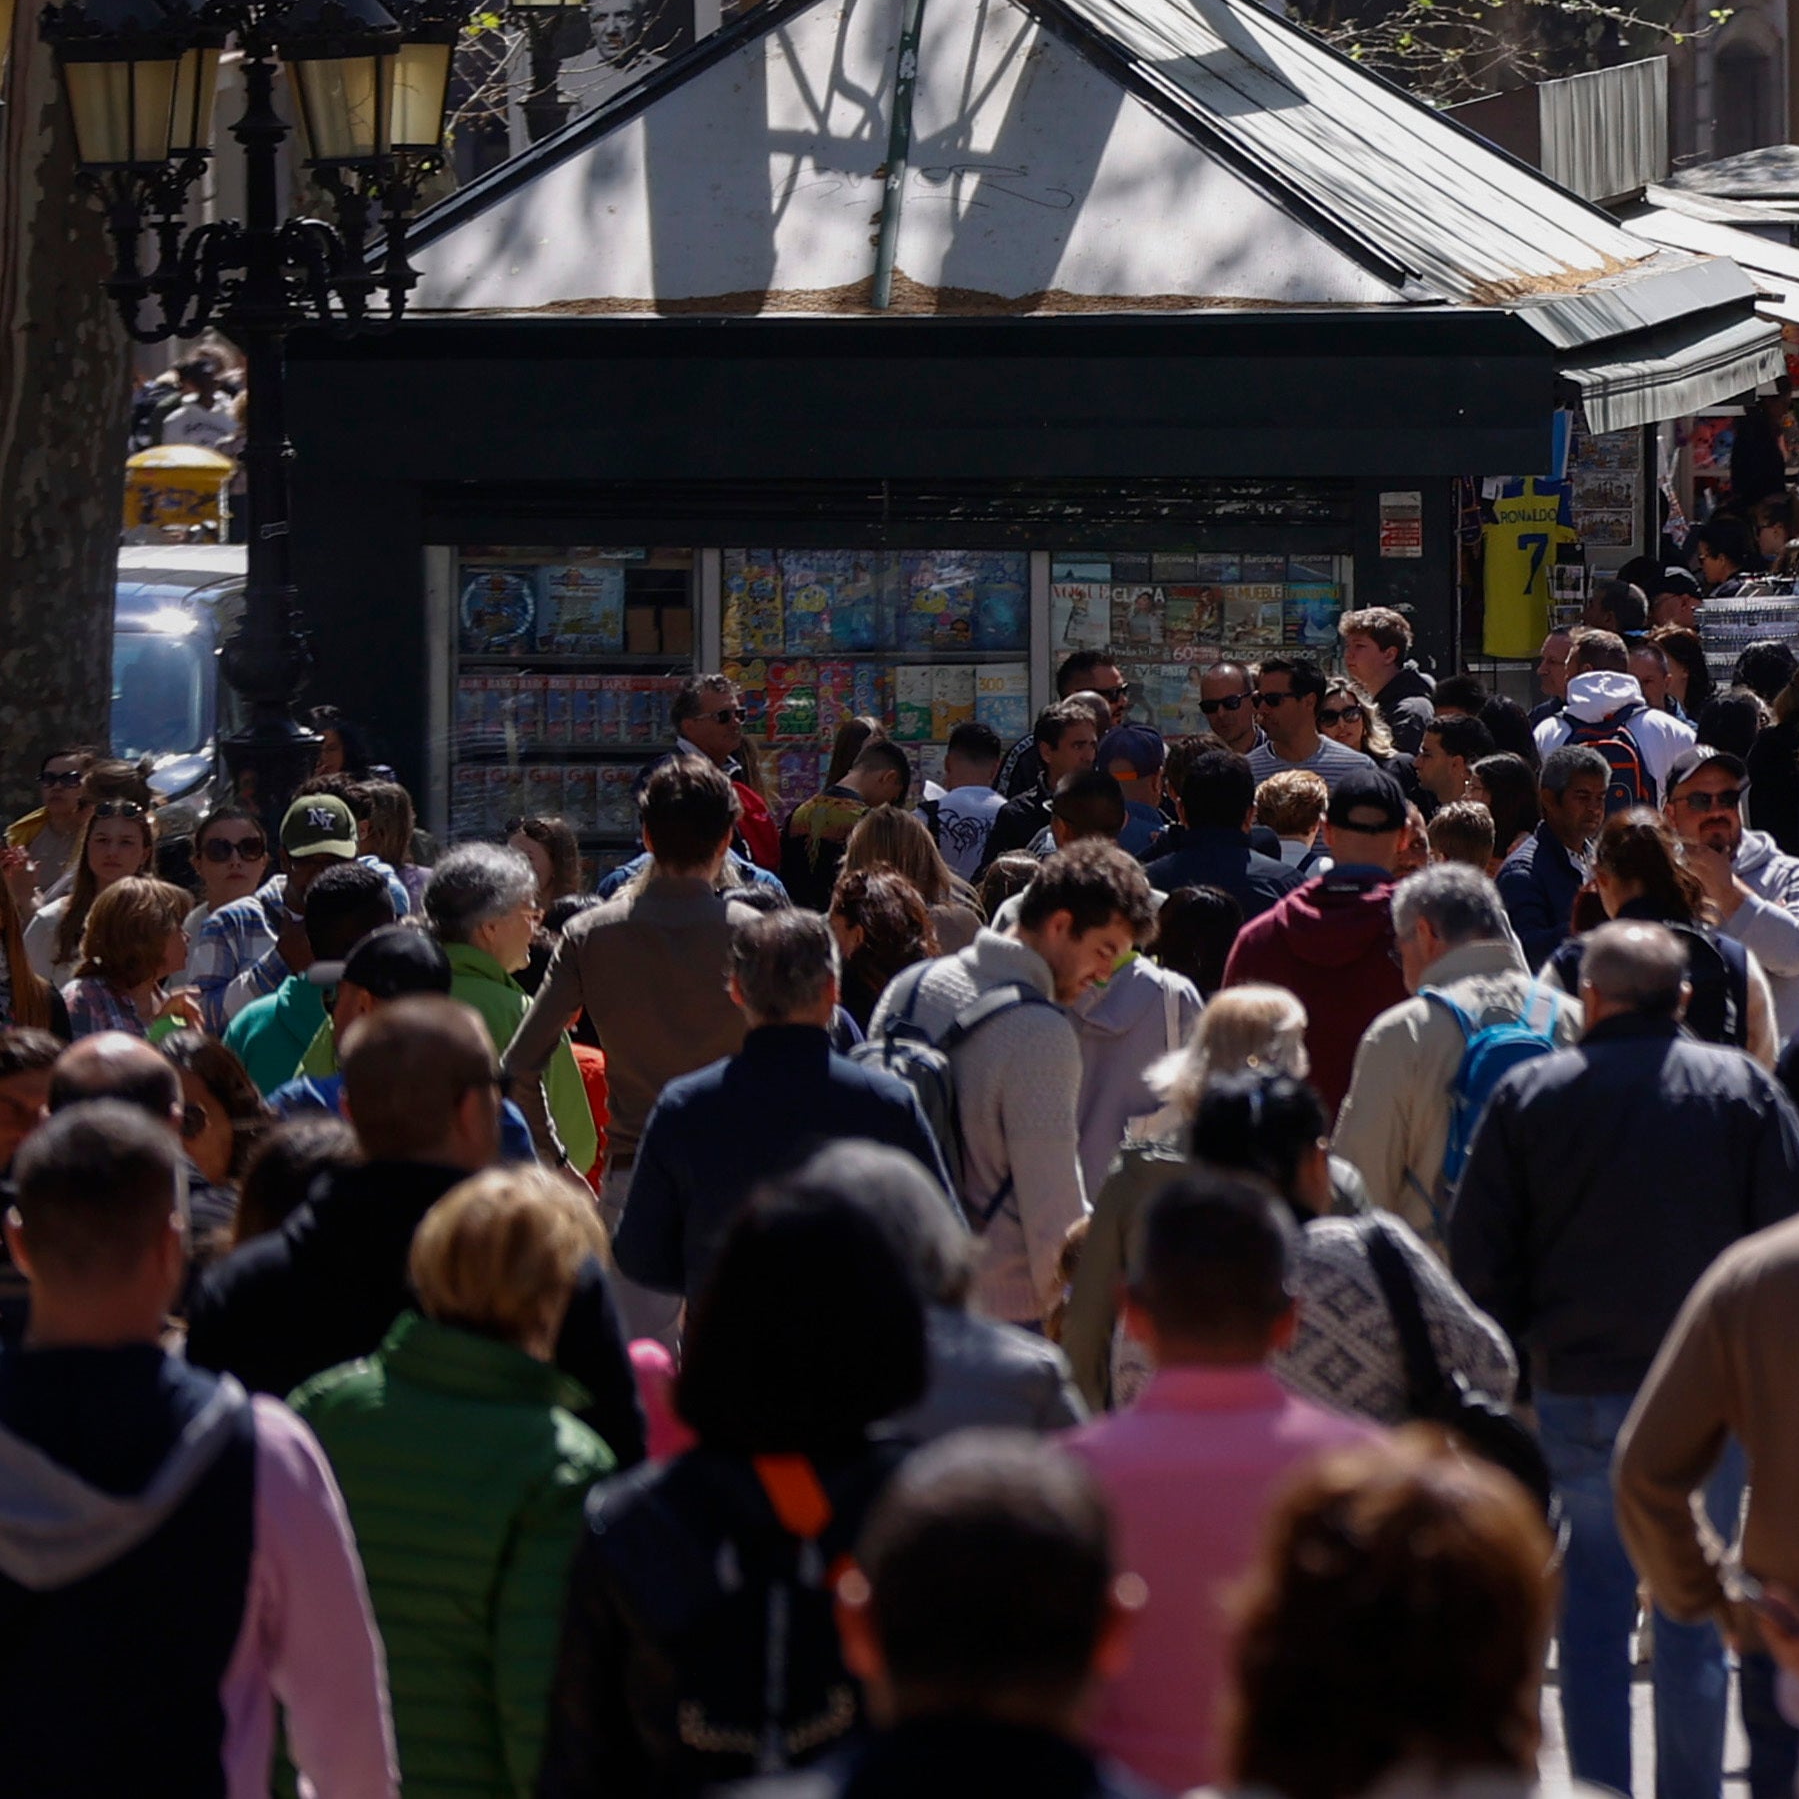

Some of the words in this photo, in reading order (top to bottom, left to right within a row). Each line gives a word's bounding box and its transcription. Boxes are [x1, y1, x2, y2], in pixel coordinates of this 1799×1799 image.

[1500, 507, 1556, 524] RONALDO
[1517, 533, 1549, 595] 7
[307, 807, 336, 831] NY
